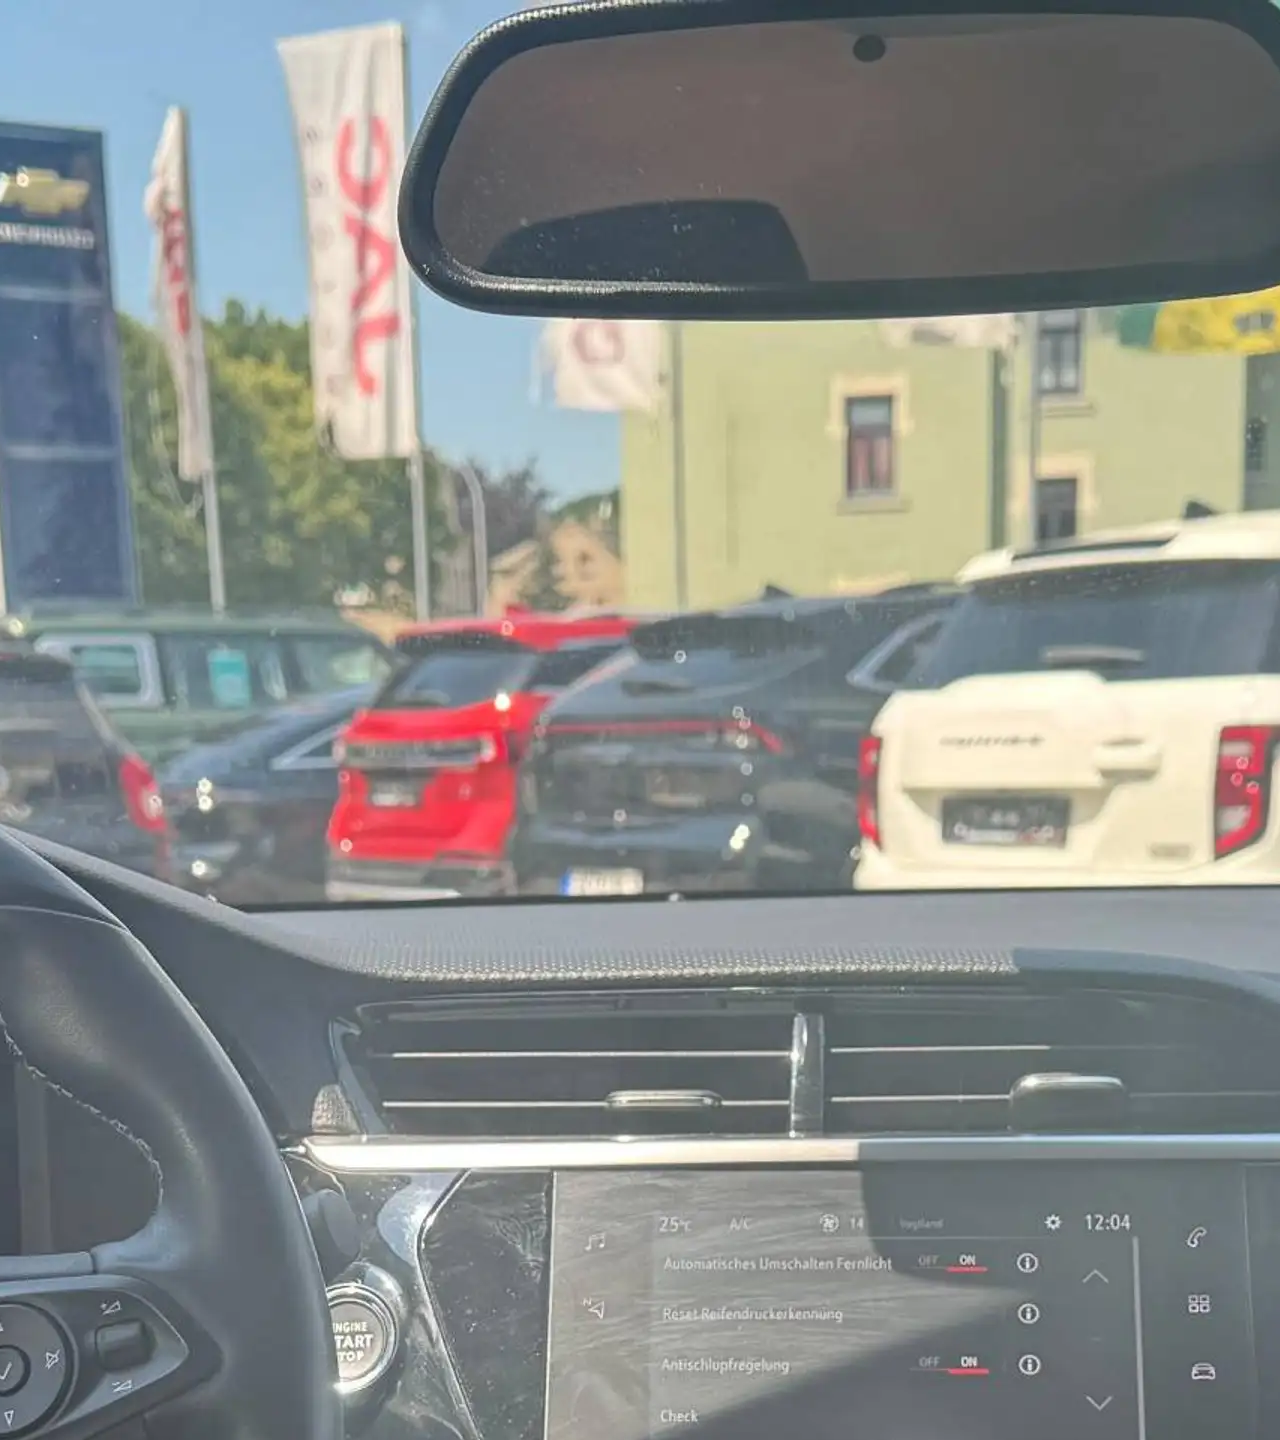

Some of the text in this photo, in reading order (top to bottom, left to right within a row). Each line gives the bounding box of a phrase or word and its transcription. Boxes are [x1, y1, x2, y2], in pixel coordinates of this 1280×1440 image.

[1084, 1214, 1131, 1231] 12:04
[664, 1256, 892, 1271] Automatisches Umschalten Fernlicht
[918, 1255, 977, 1266] OFF ON
[663, 1307, 697, 1321] Reset
[334, 1334, 374, 1349] TART
[337, 1350, 364, 1361] TOP
[919, 1356, 977, 1367] OFF ON
[661, 1358, 790, 1375] Antischlupfregelung
[660, 1409, 698, 1423] Check
